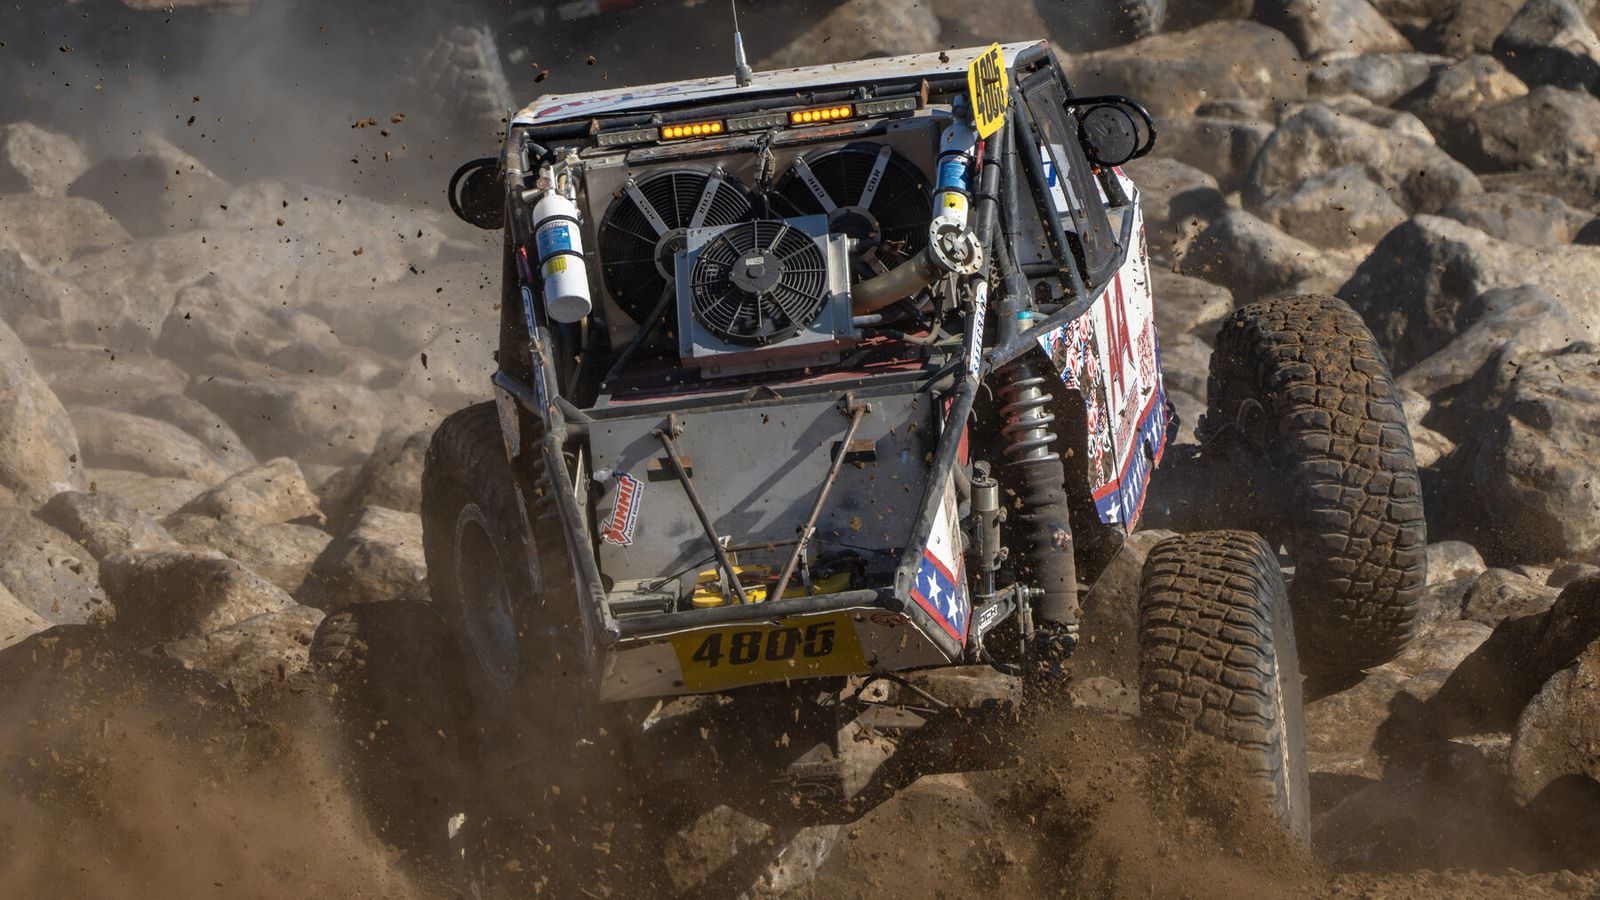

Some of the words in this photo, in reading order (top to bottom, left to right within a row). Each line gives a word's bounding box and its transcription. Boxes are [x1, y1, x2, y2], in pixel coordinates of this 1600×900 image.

[974, 48, 1005, 126] 4805
[627, 515, 636, 537] RACING
[632, 483, 643, 515] EQUIPMENT
[691, 620, 836, 668] 4805
